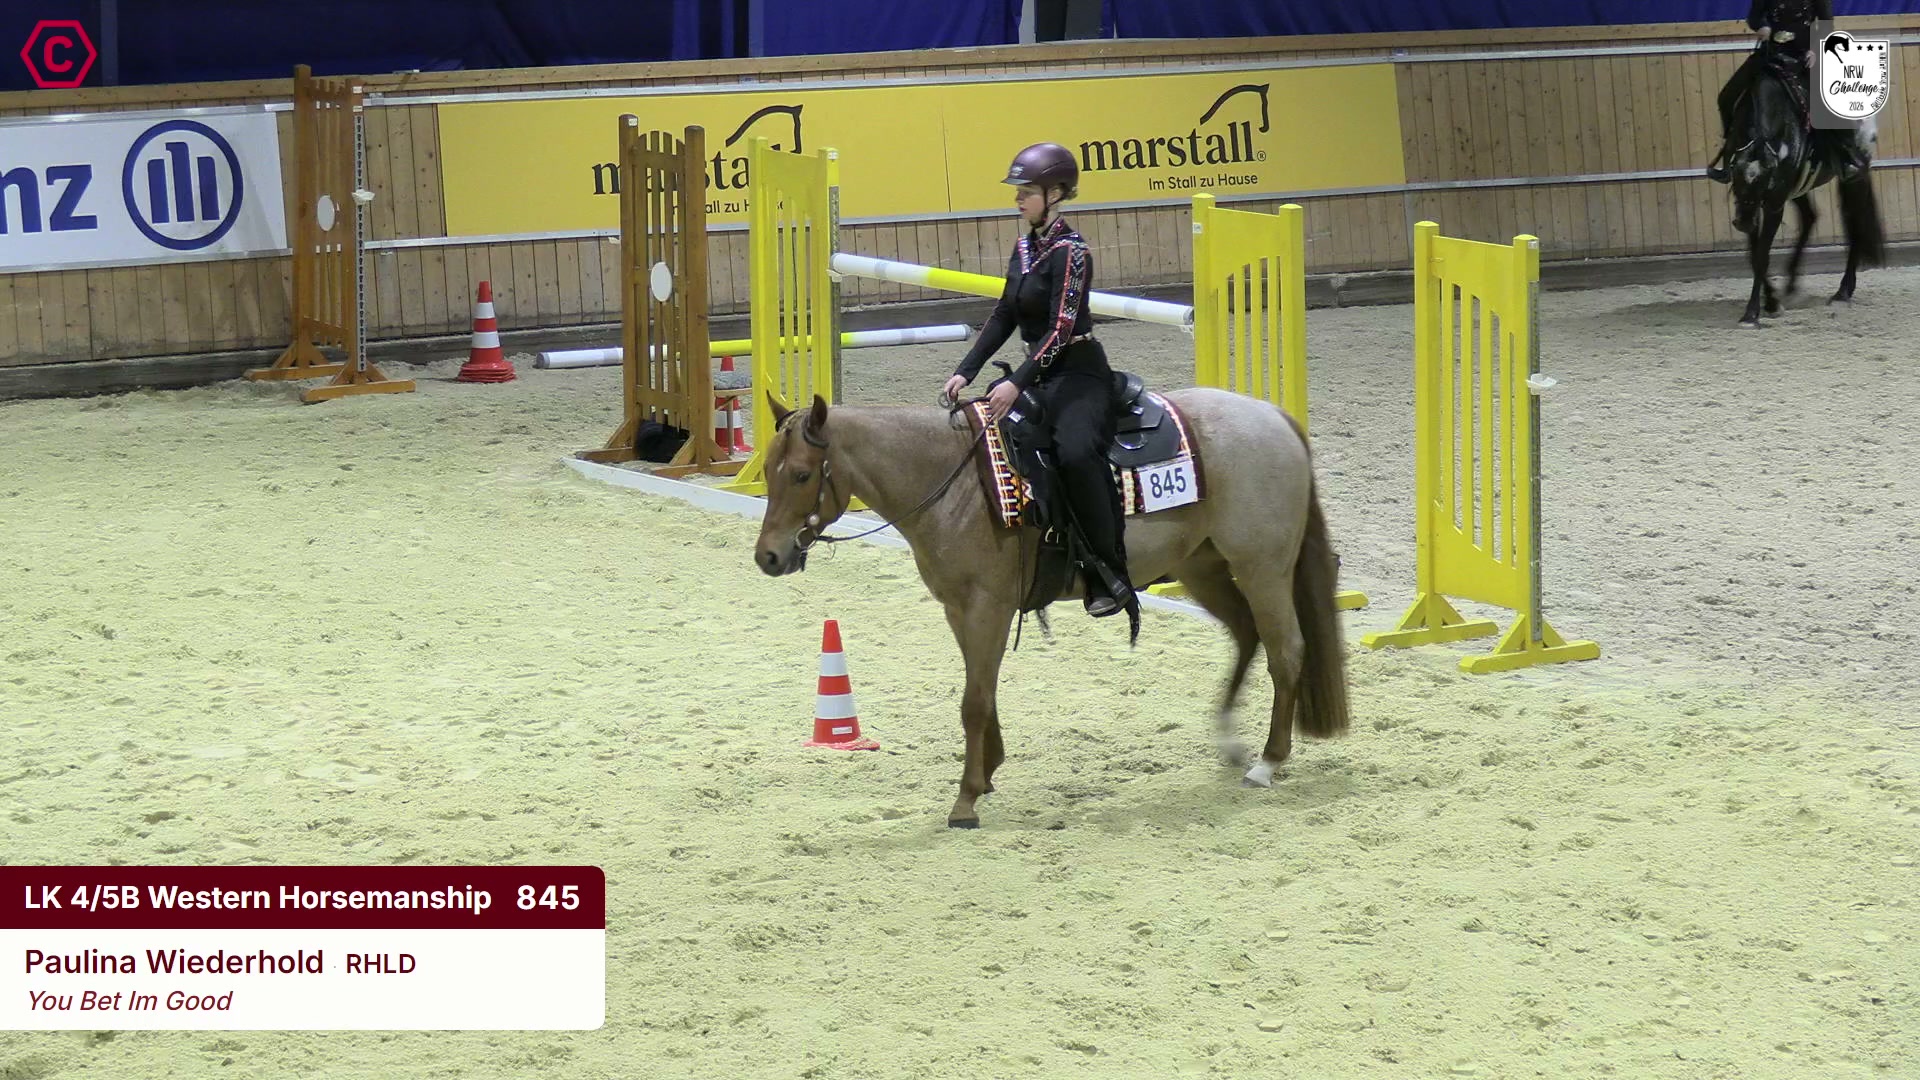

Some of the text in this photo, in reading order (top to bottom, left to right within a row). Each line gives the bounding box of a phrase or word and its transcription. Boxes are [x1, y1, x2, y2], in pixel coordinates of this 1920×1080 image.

[1148, 173, 1258, 190] Im Stall zu Hause
[724, 202, 740, 213] zu
[1150, 467, 1186, 499] 845
